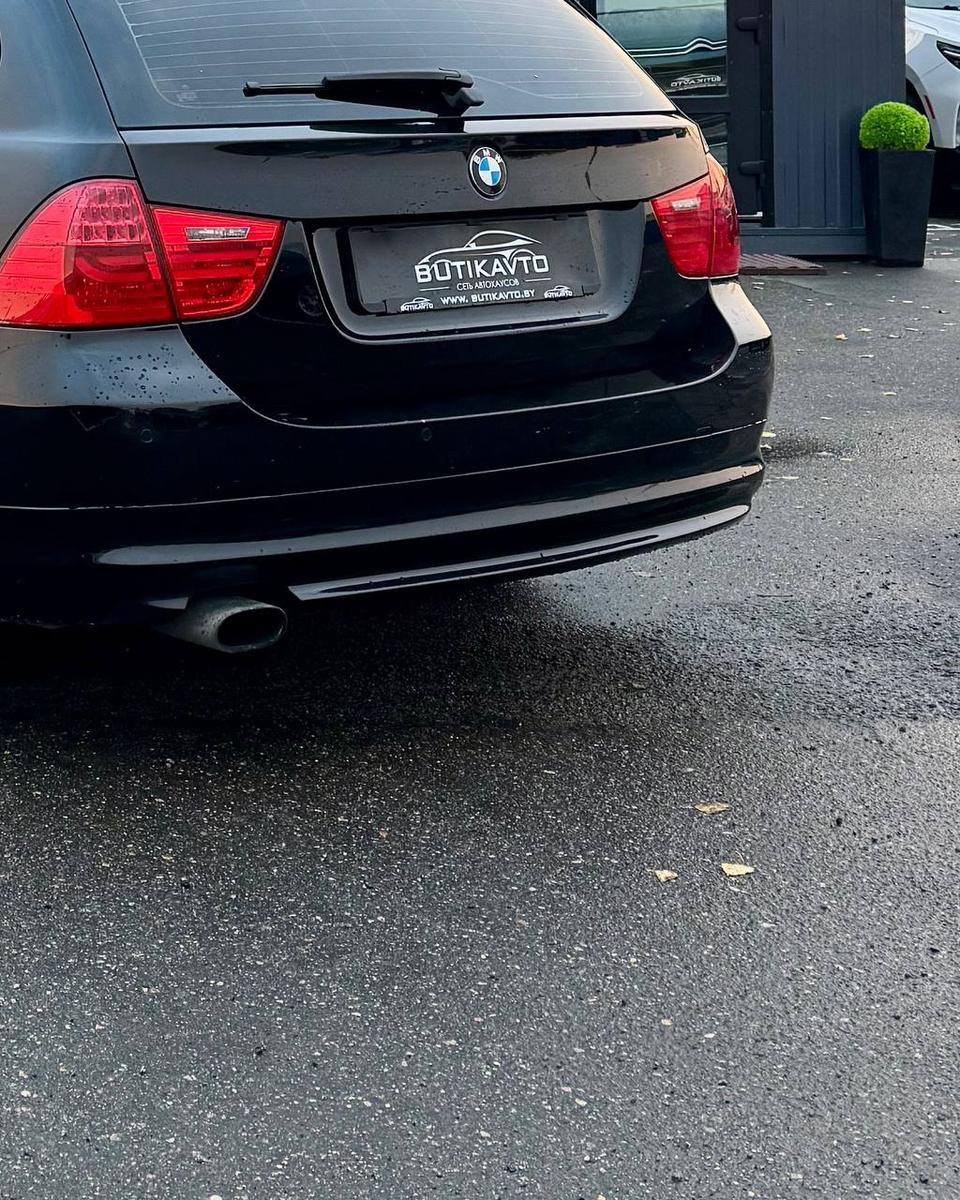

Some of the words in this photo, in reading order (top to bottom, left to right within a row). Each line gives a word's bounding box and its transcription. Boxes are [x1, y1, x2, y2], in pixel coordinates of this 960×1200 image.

[414, 254, 550, 283] BUTIKAVTO
[456, 282, 473, 291] СЕТЬ
[474, 278, 520, 290] АВТОХАУСОВ
[440, 294, 469, 305] WWW.
[470, 289, 536, 303] BUTIKAVTO.BY
